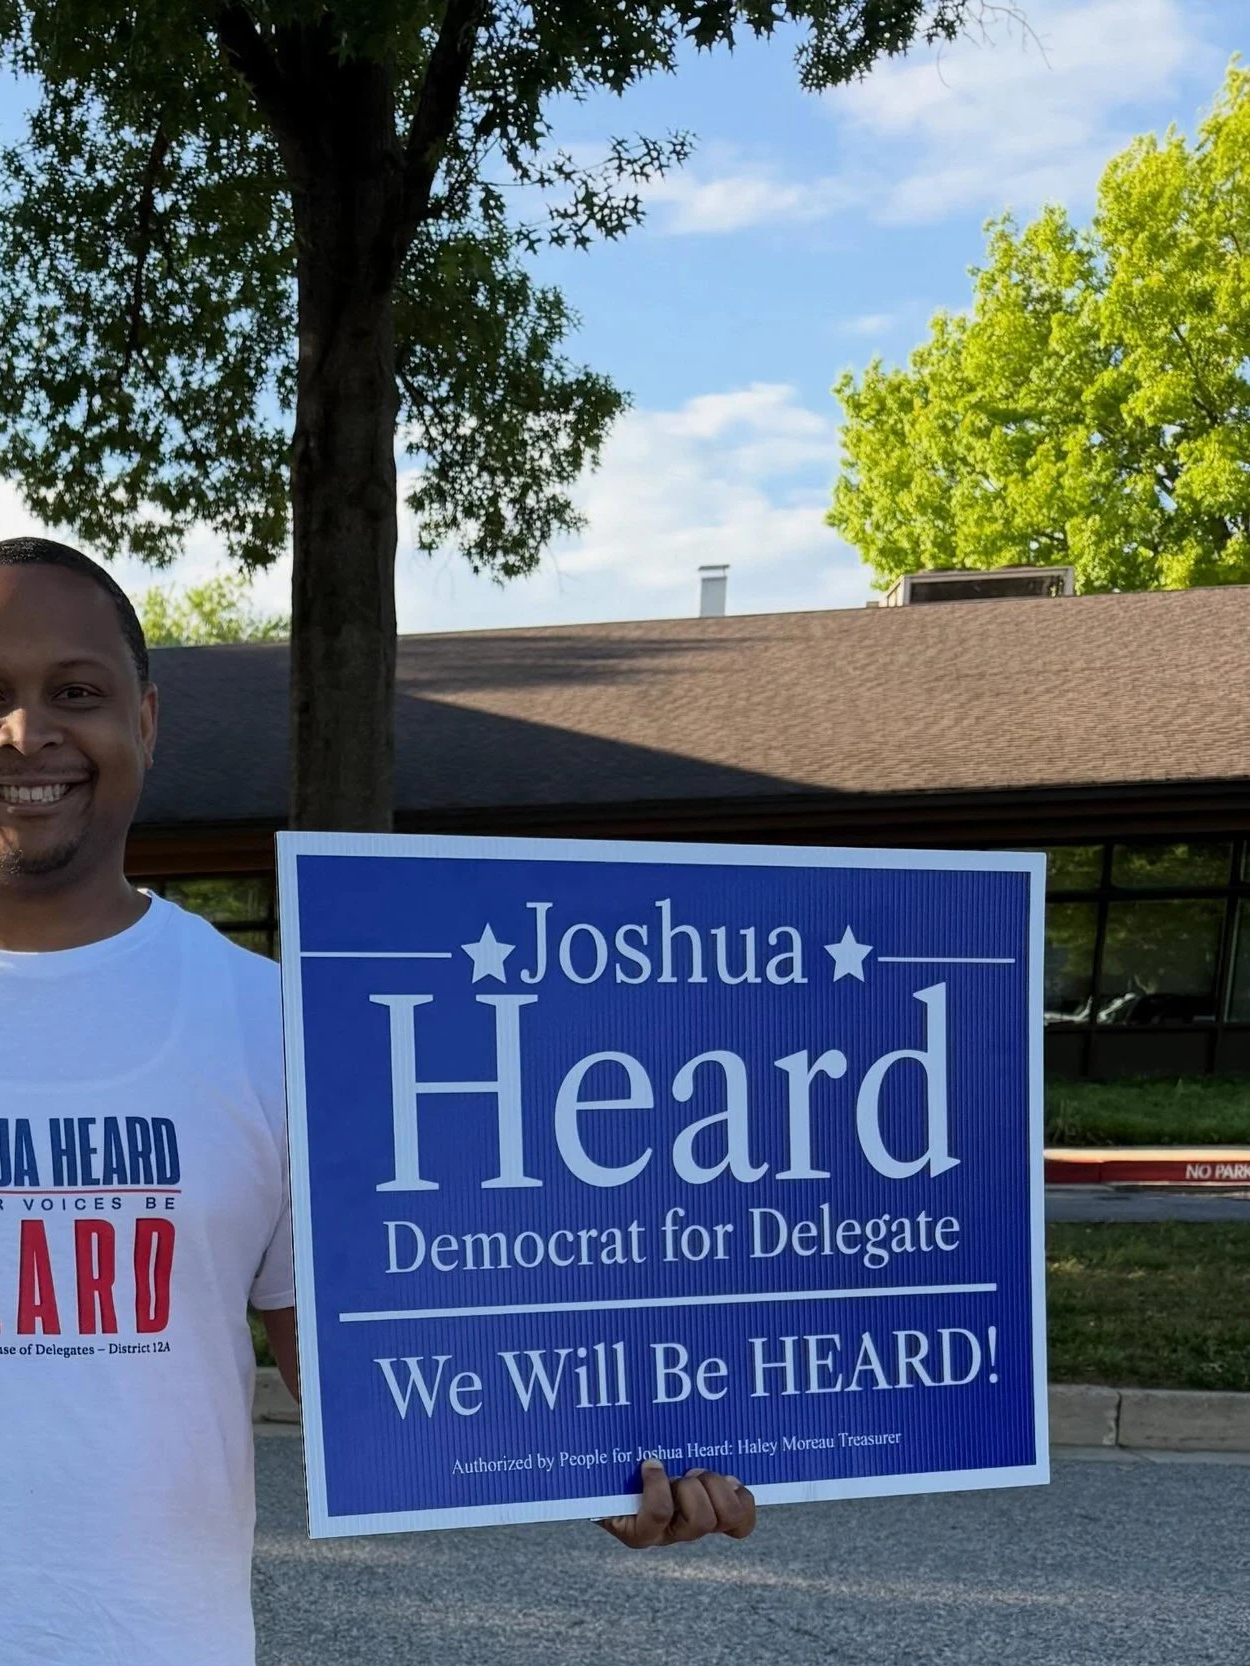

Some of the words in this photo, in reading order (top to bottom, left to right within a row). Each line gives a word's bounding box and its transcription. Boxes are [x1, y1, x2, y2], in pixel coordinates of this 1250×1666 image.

[519, 898, 808, 986] Joshua
[369, 981, 961, 1193] Heard
[48, 1116, 181, 1187] HEARD
[1185, 1163, 1212, 1179] NO
[1214, 1163, 1250, 1179] PARK
[24, 1196, 123, 1211] VOICES
[145, 1196, 175, 1210] BE
[384, 1219, 646, 1275] Democrat
[661, 1207, 734, 1261] for
[749, 1202, 961, 1269] Delegate
[19, 1343, 32, 1355] of
[35, 1343, 95, 1359] Delegates
[109, 1341, 150, 1354] District
[153, 1341, 171, 1353] 12A
[373, 1353, 484, 1420] We
[498, 1341, 631, 1411] Will
[651, 1342, 729, 1404] Be
[749, 1325, 1000, 1398] HEARD!
[452, 1454, 532, 1474] Authorized
[537, 1453, 555, 1472] by
[559, 1449, 607, 1469] People
[612, 1447, 632, 1463] for
[636, 1444, 683, 1461] Joshua
[687, 1440, 733, 1458] Heard:
[737, 1438, 778, 1456] Haley
[782, 1434, 834, 1452] Moreau
[838, 1431, 902, 1448] Treasurer
